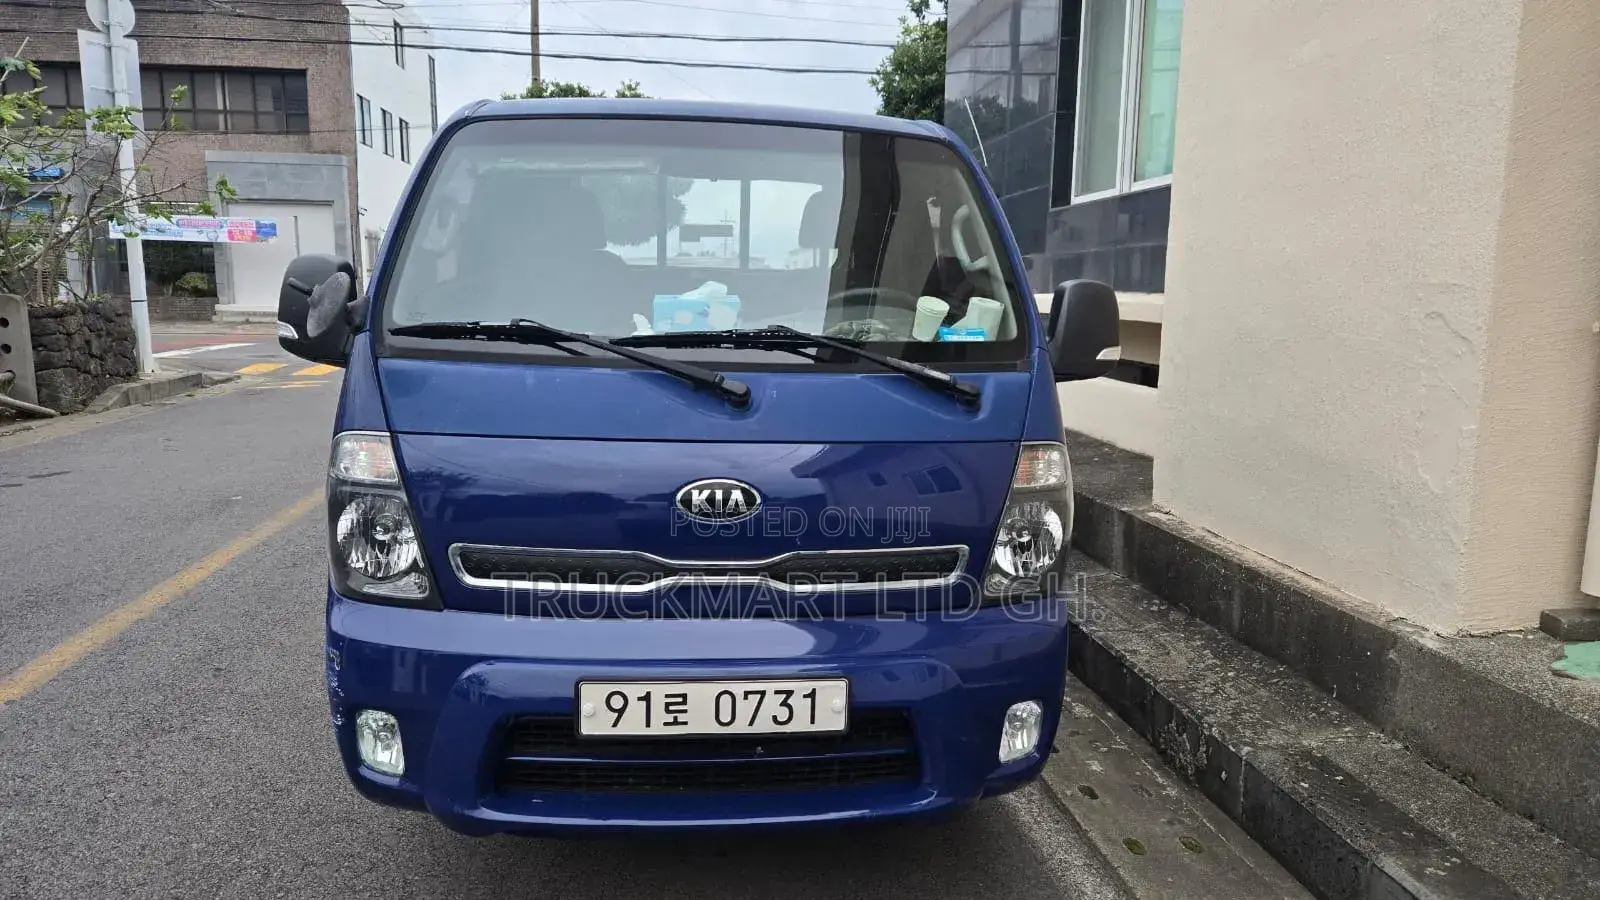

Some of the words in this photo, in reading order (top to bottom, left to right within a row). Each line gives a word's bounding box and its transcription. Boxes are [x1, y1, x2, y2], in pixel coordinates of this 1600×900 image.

[690, 488, 748, 513] KIA
[604, 690, 689, 728] 91로
[713, 687, 817, 727] 0731
